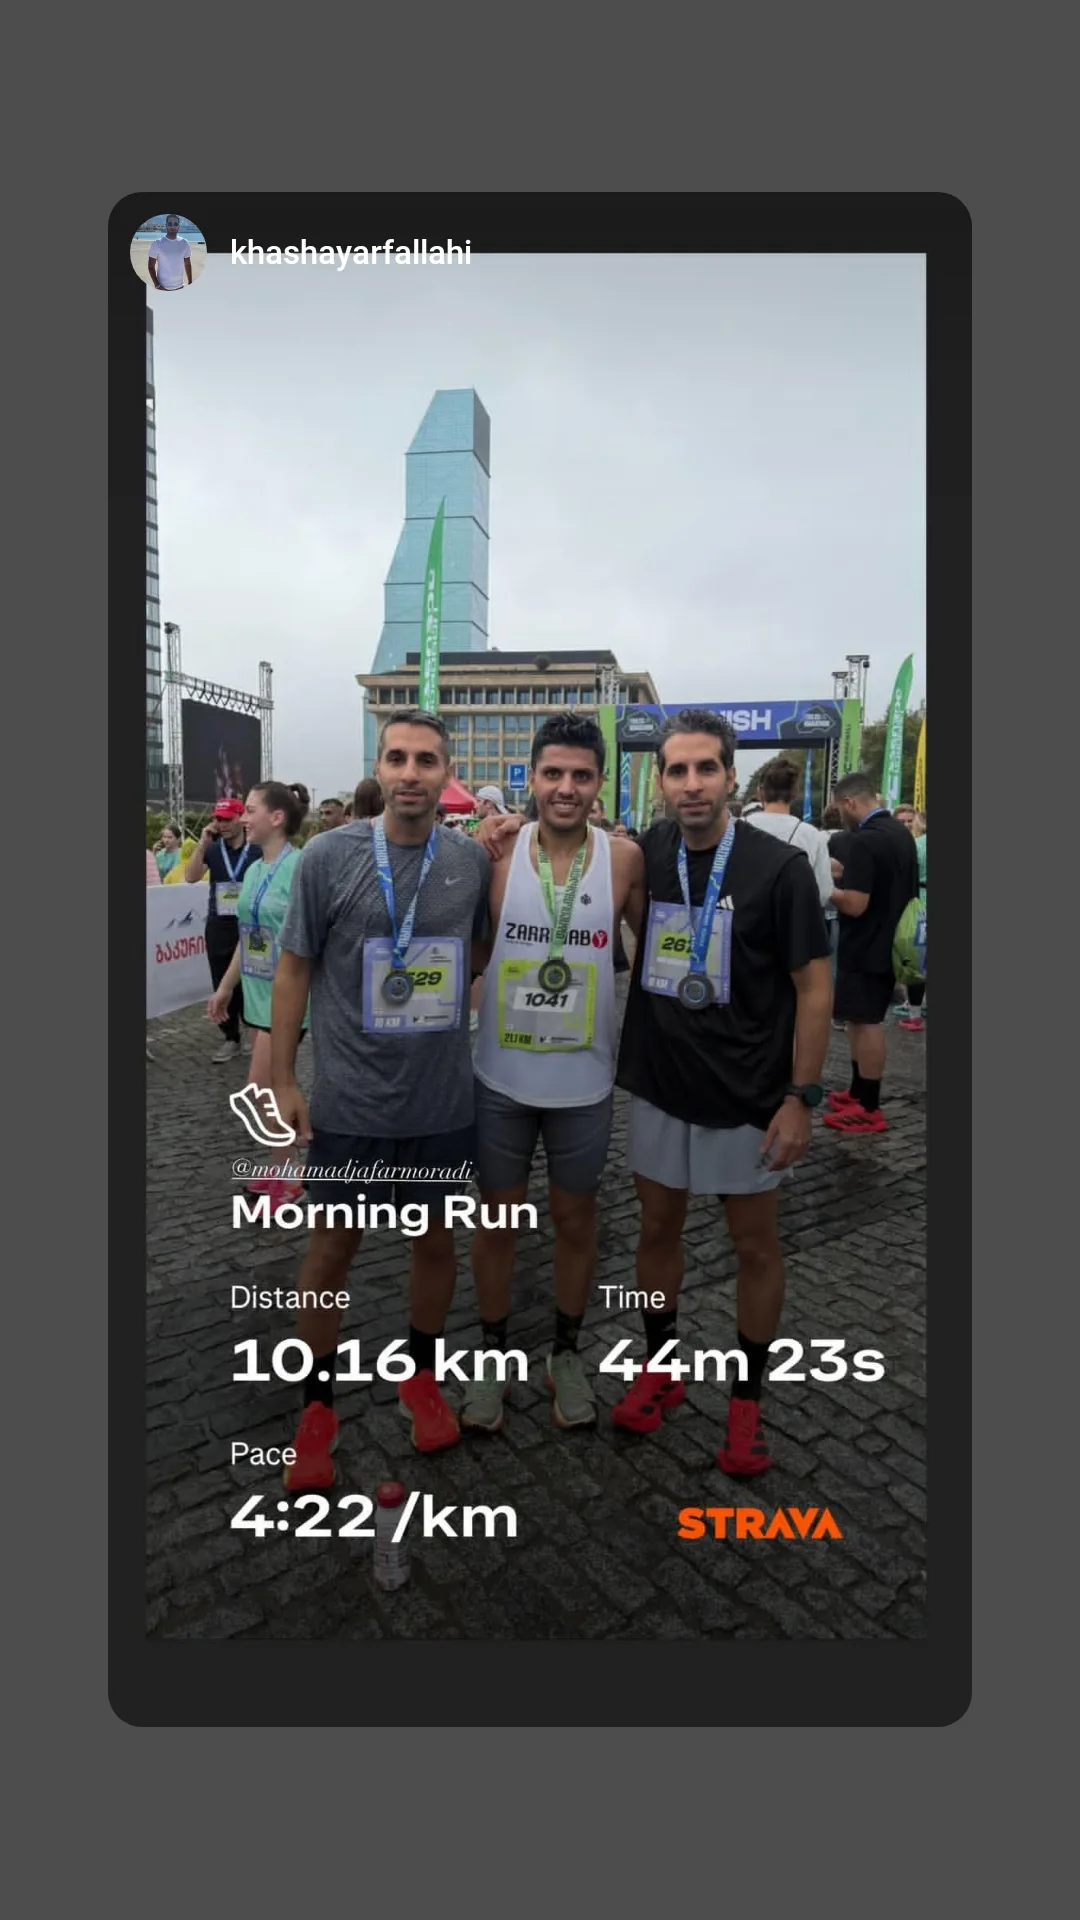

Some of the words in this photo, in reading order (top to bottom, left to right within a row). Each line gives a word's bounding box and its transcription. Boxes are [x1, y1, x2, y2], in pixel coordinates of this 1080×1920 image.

[720, 709, 772, 731] ISH
[505, 922, 591, 946] ZARRAB
[524, 991, 569, 1008] 1041
